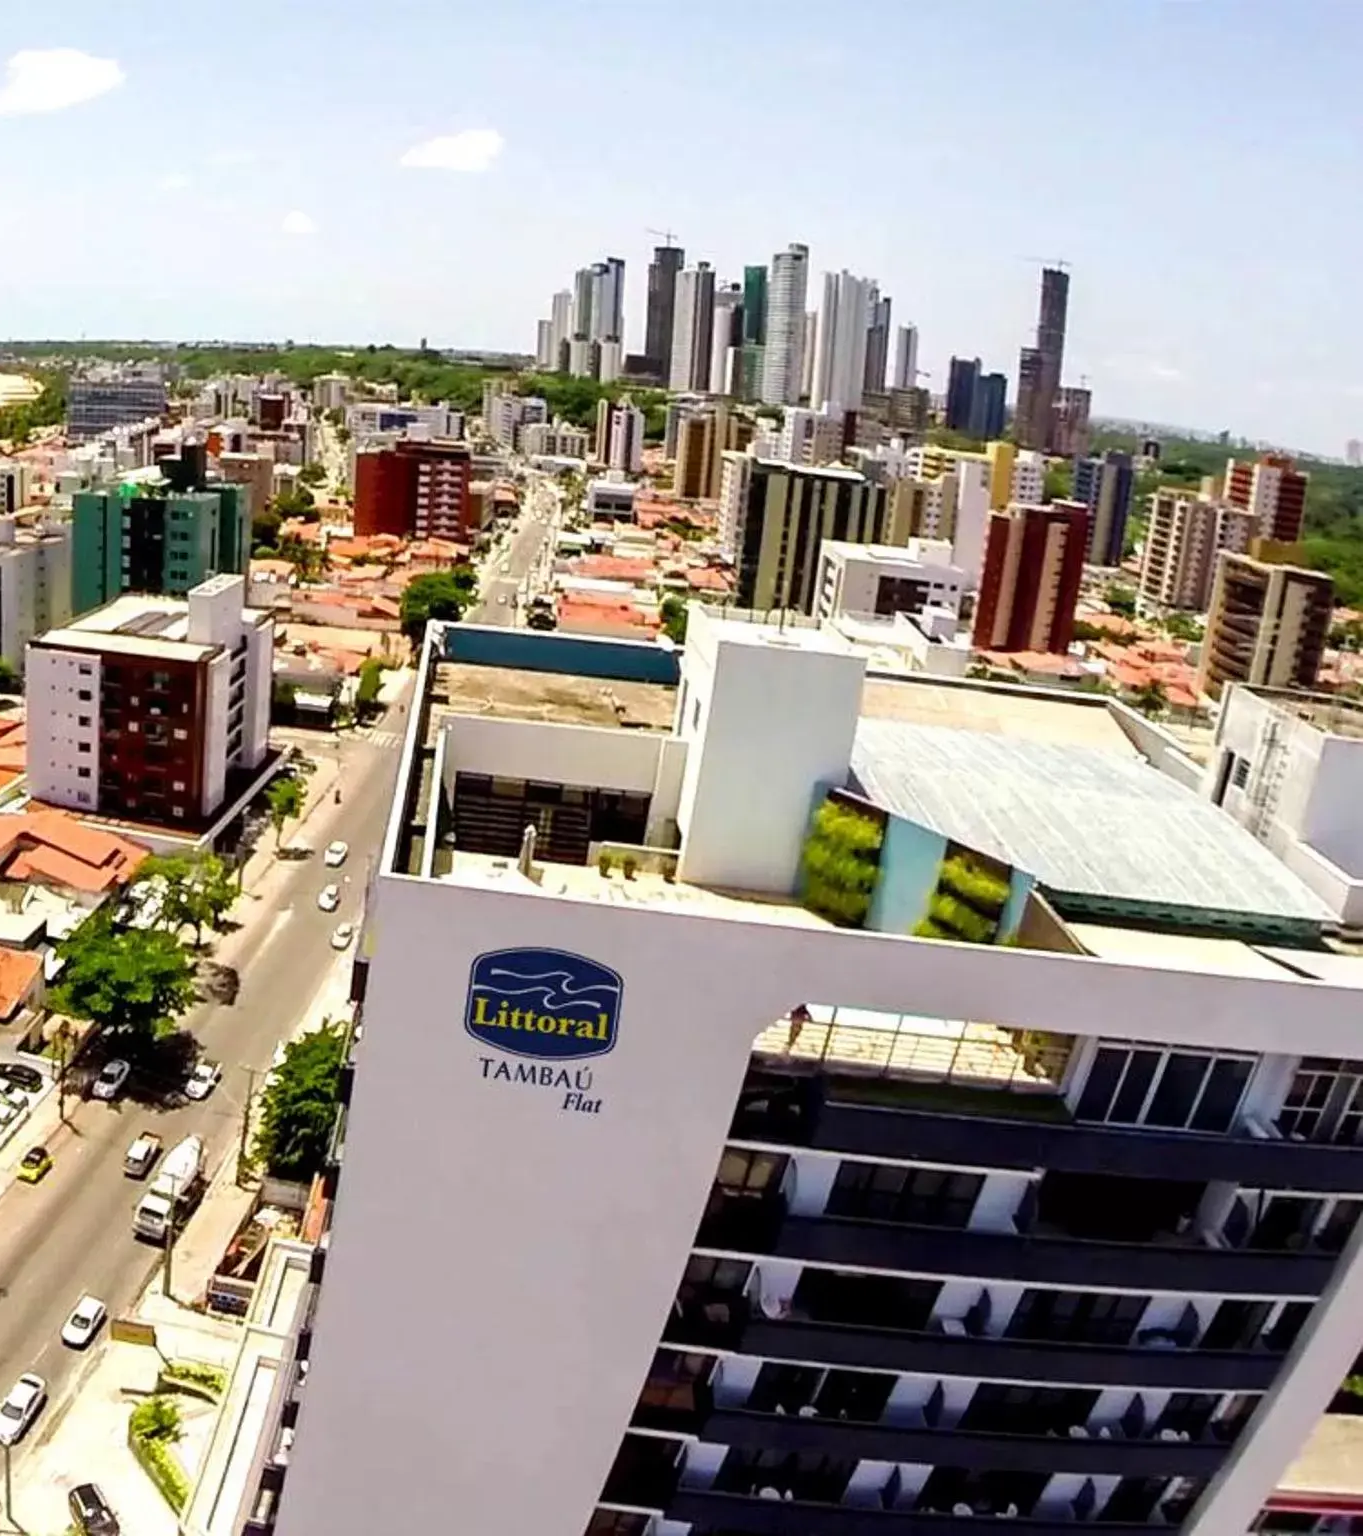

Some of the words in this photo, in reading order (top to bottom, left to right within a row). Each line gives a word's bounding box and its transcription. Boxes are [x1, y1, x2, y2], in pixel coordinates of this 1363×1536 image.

[472, 997, 609, 1041] Littoral
[479, 1057, 593, 1092] TAMBAÚ
[562, 1092, 603, 1114] Flat
